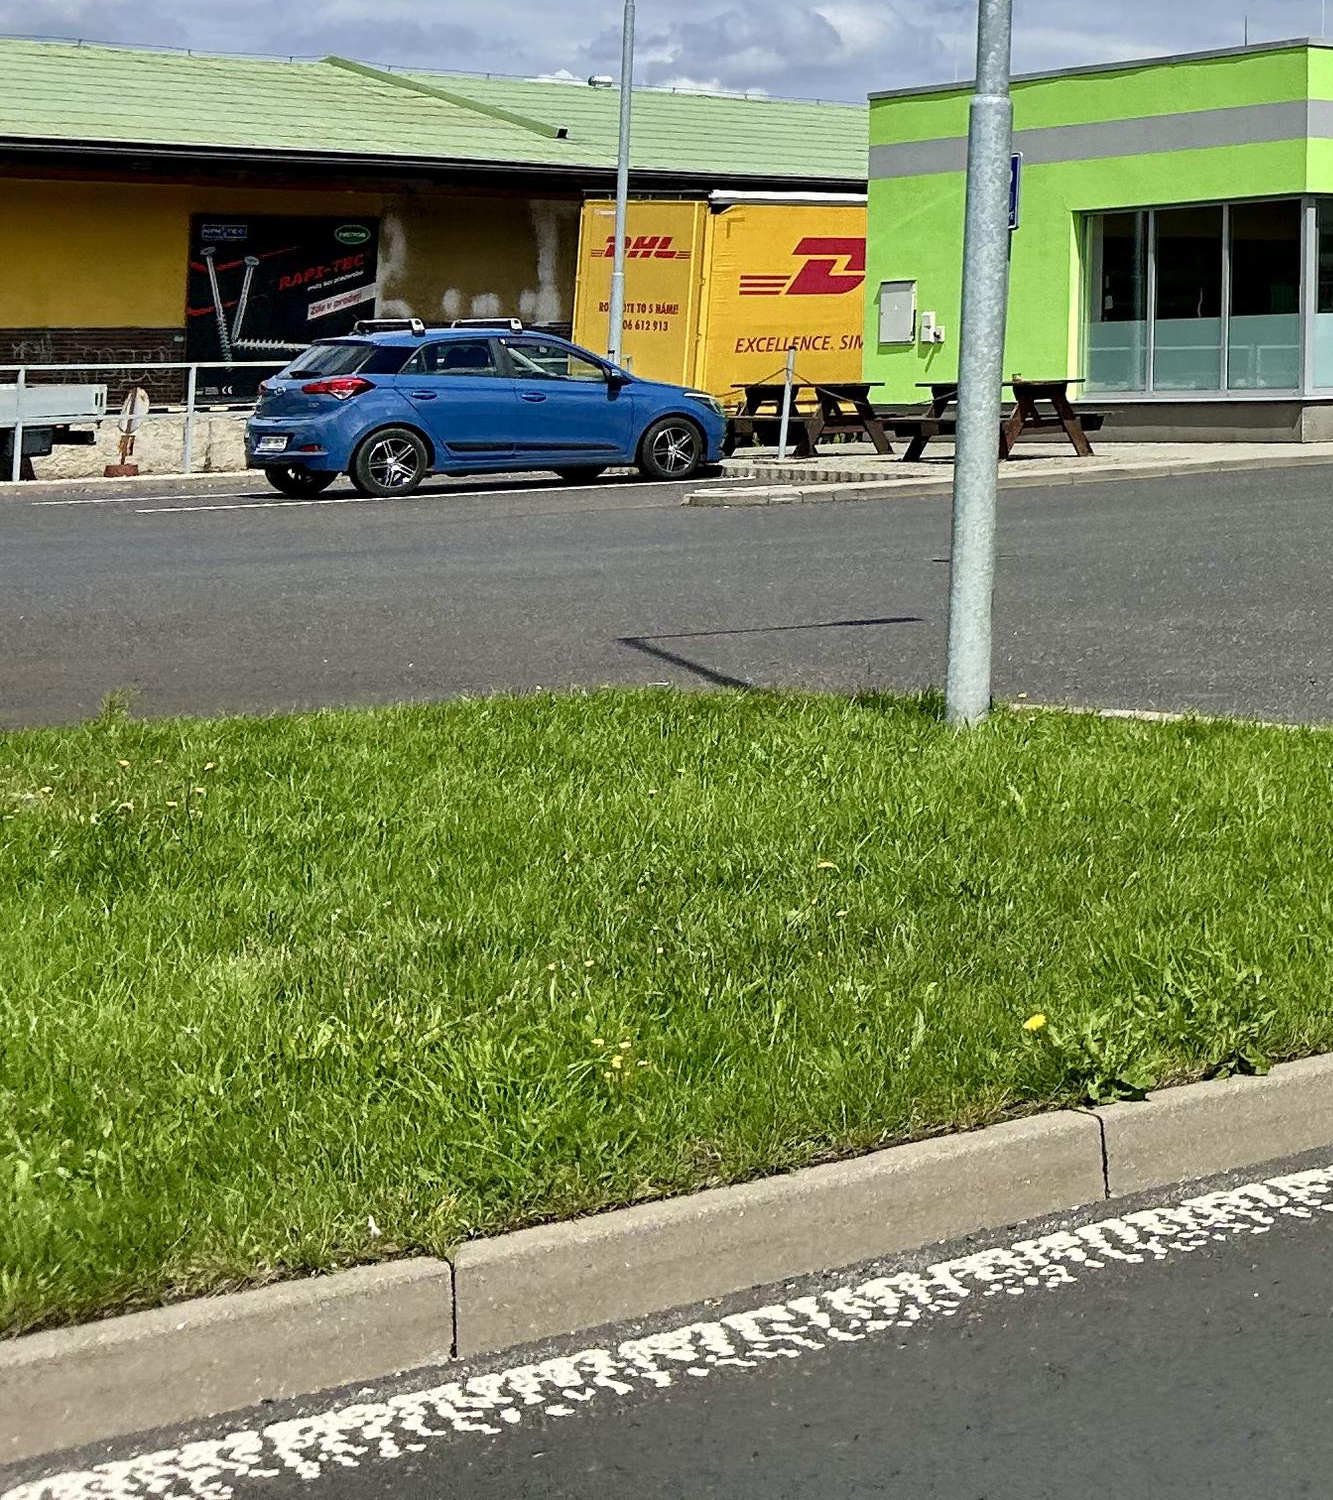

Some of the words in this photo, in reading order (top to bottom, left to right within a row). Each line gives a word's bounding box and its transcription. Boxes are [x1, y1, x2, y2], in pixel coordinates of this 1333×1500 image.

[604, 236, 678, 258] DHL
[635, 320, 651, 331] 612
[653, 321, 669, 331] 913
[735, 336, 834, 353] EXCELLENCE.
